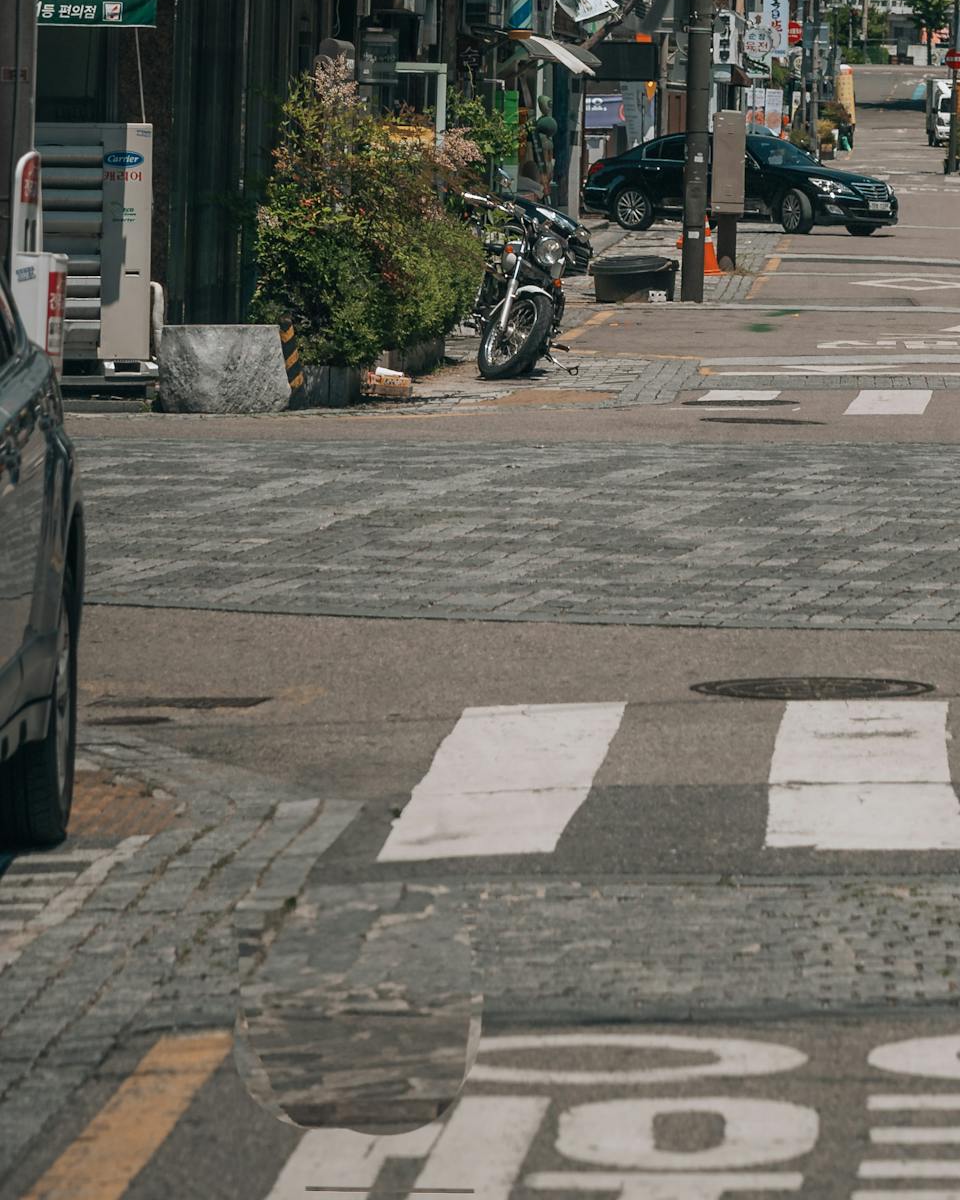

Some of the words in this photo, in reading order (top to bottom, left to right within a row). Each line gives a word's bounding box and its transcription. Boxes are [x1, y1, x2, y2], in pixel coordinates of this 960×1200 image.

[58, 4, 97, 19] 편의점
[107, 154, 140, 164] Carrier
[104, 171, 142, 182] 캐리어
